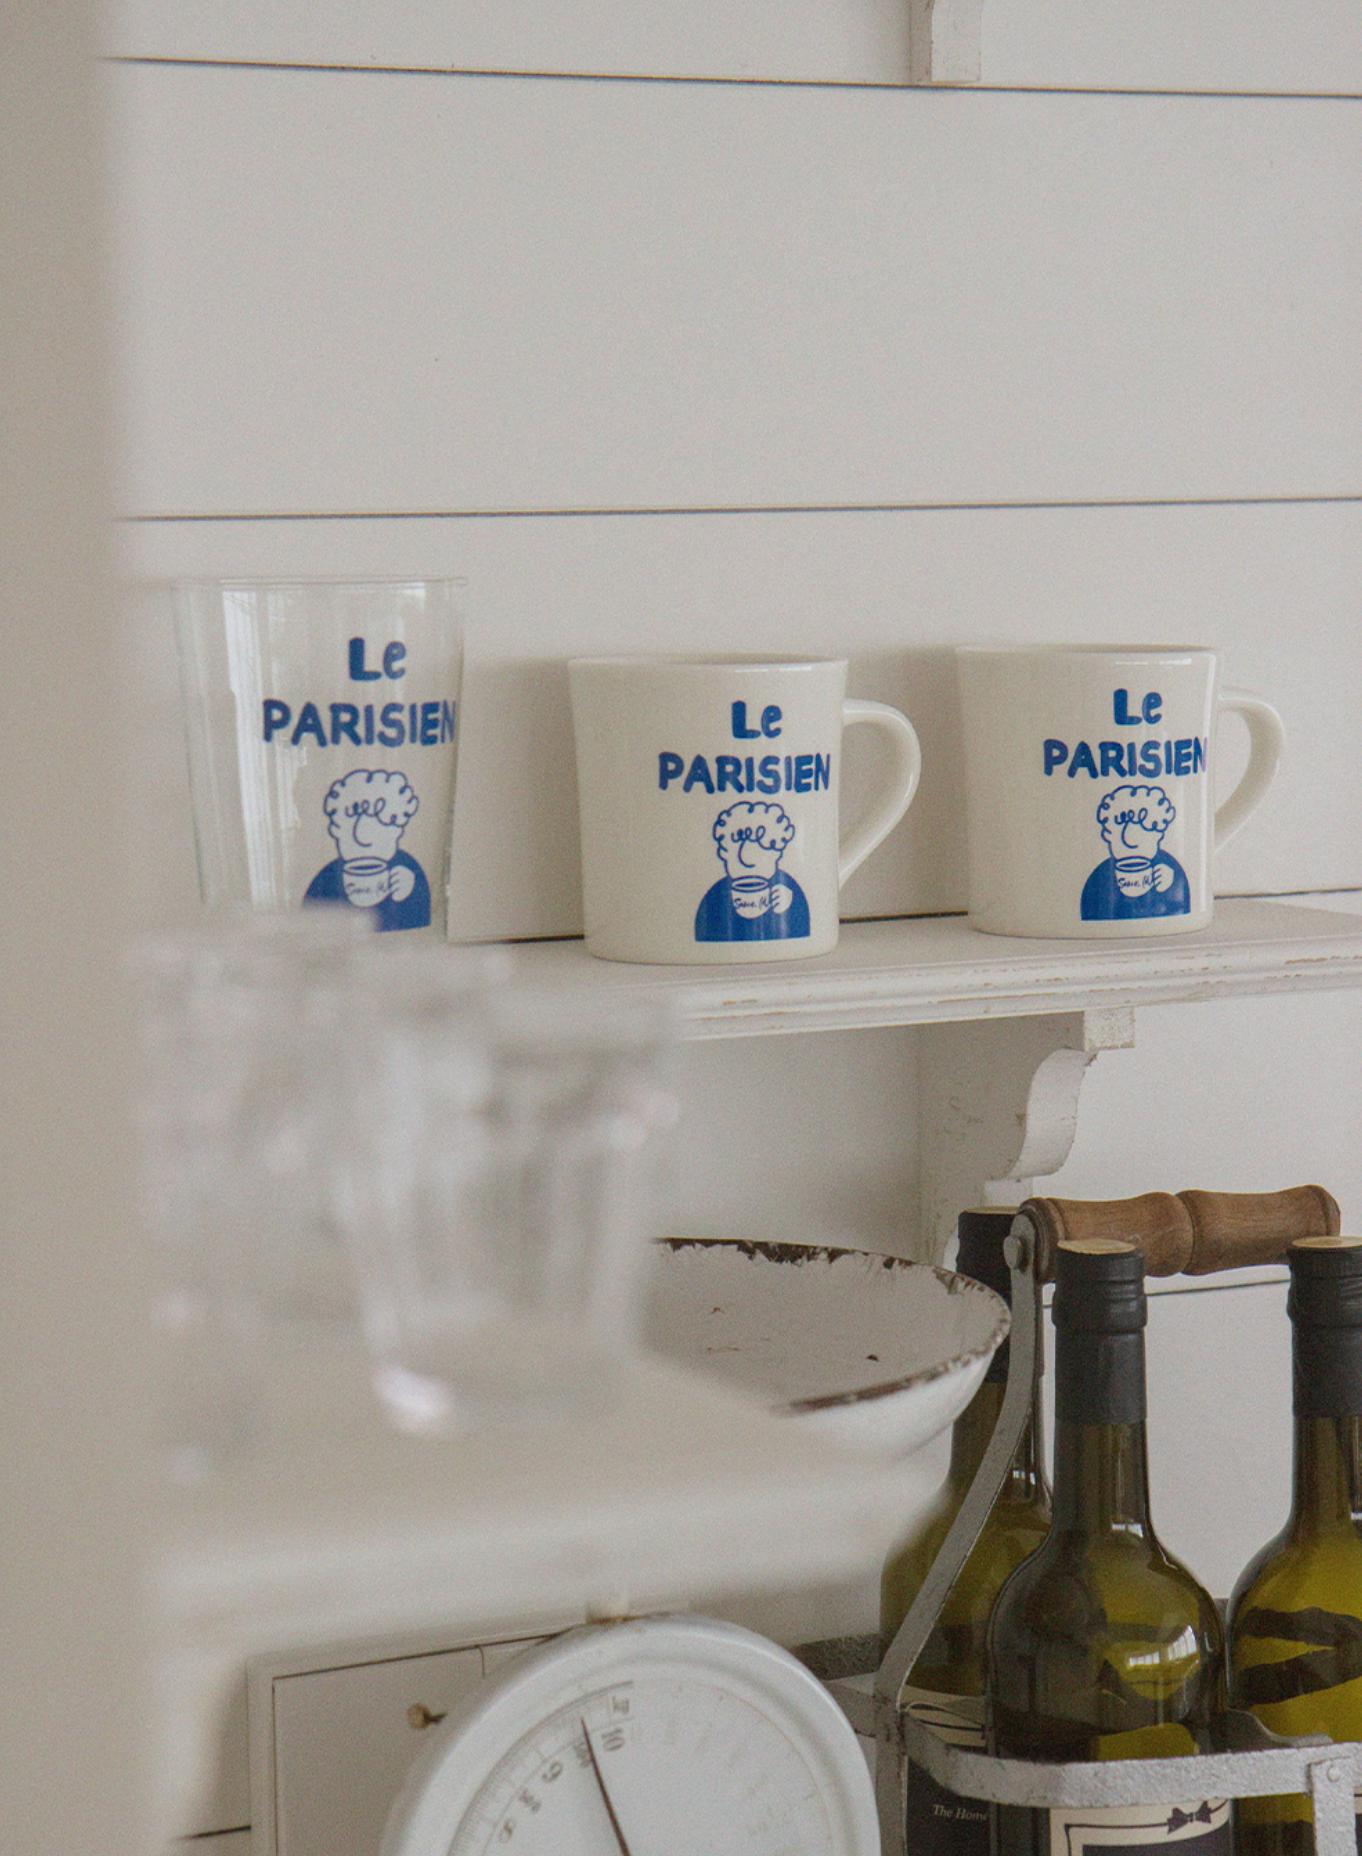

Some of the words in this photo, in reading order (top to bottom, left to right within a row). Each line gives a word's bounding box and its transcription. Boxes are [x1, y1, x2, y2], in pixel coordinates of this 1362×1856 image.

[348, 637, 407, 682] Le
[262, 699, 457, 748] PARISIEN
[731, 700, 782, 740] Le
[1113, 688, 1162, 726] Le
[659, 752, 831, 795] PARISIEN
[1043, 736, 1209, 780] PARISIEN
[933, 1804, 953, 1818] The
